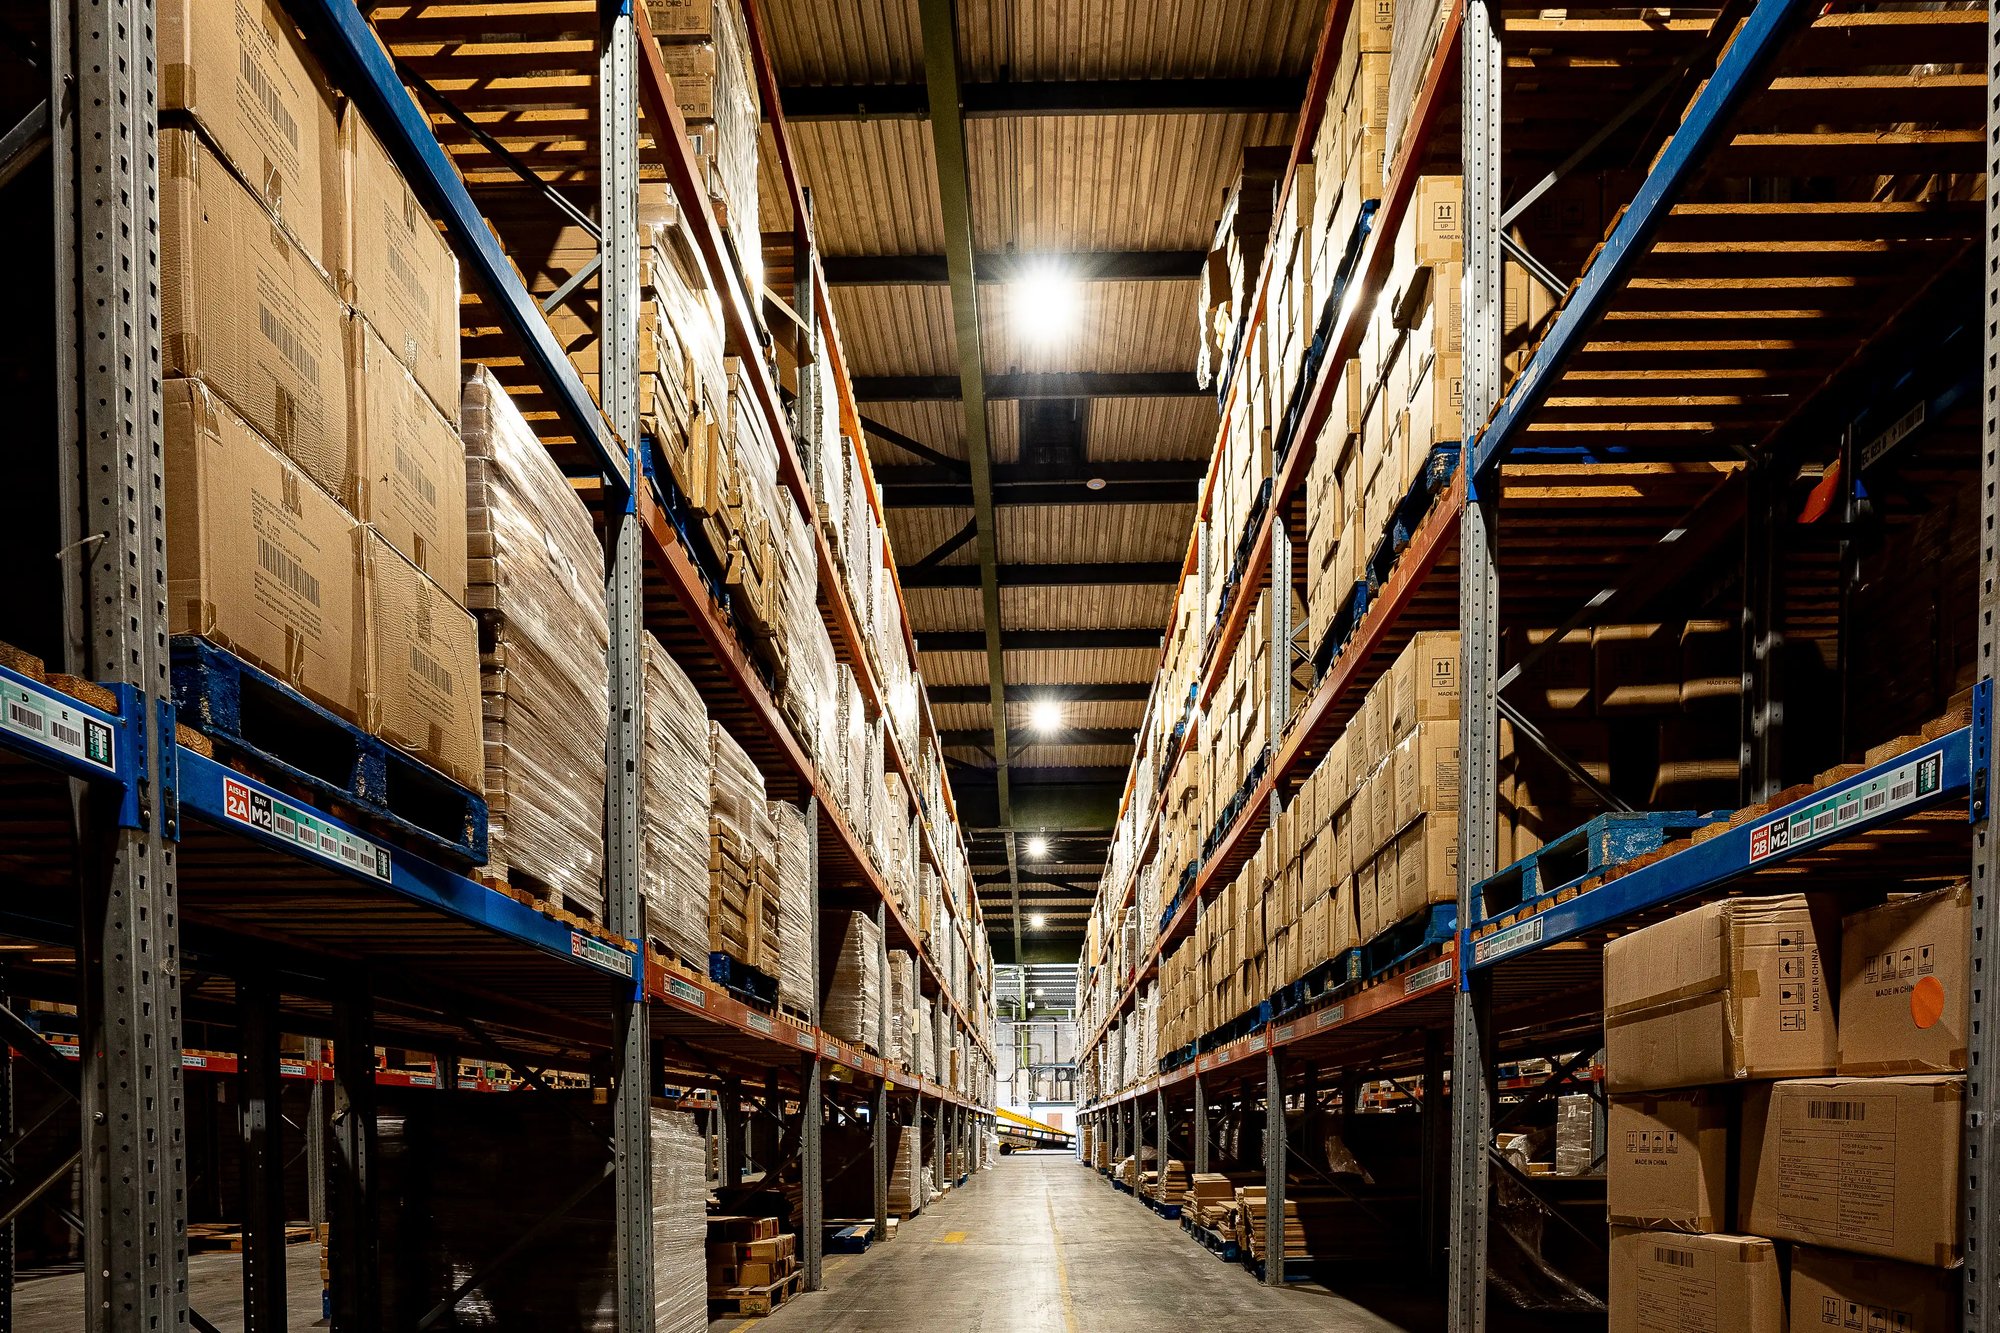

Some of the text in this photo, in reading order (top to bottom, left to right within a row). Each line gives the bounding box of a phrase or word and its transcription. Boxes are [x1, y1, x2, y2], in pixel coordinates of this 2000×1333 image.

[22, 692, 68, 720] D E
[228, 785, 247, 798] AISLE
[228, 796, 248, 818] 2A
[254, 796, 267, 807] BAY
[252, 806, 271, 827] M2
[1774, 822, 1785, 832] BAY
[1754, 830, 1768, 840] AISLE
[1771, 831, 1787, 849] M2
[1753, 840, 1767, 857] 2B
[1876, 989, 1892, 997] MADE
[1900, 985, 1914, 993] CHIN
